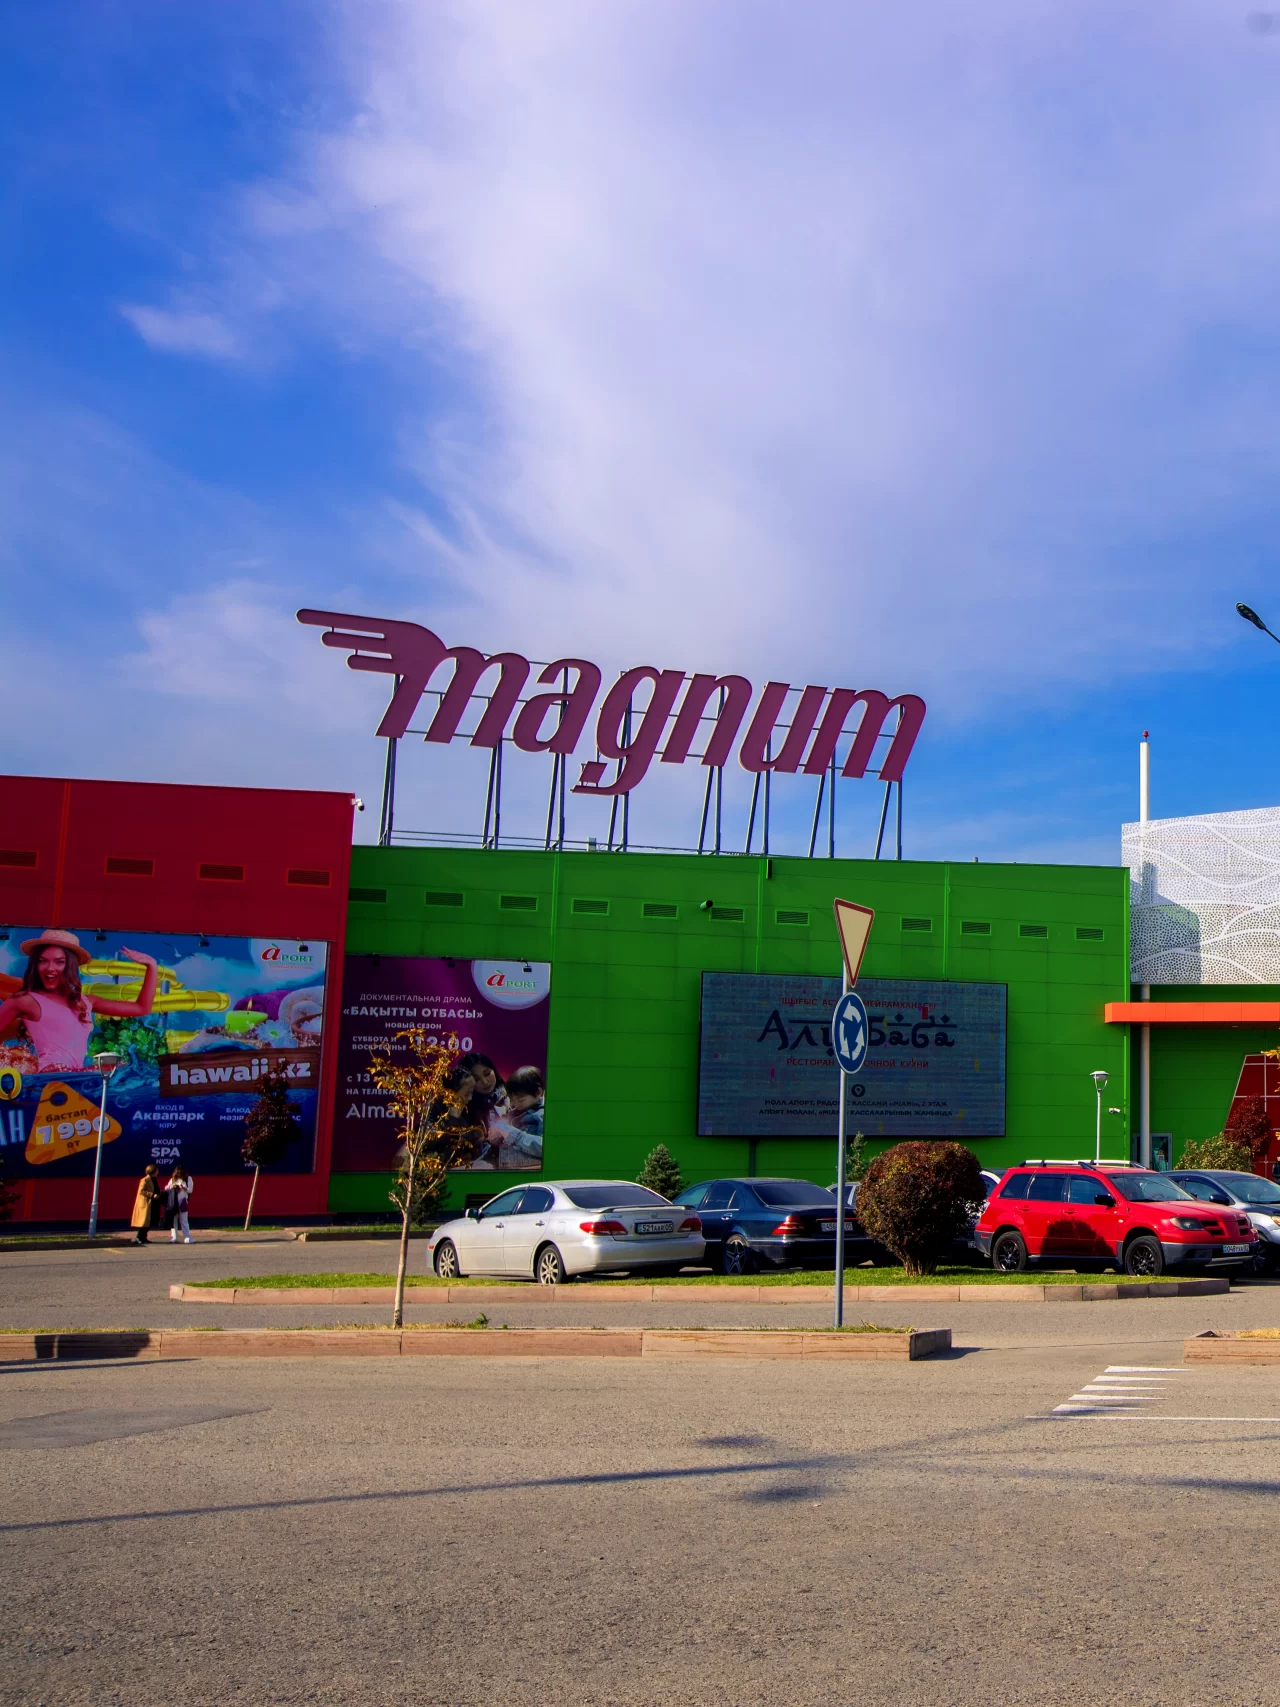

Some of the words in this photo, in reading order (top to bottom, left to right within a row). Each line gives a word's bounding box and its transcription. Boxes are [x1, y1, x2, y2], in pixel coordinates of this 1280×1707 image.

[297, 608, 927, 796] magnum
[359, 993, 440, 1003] ДОКУМЕНТАЛЬНАЯ
[442, 996, 472, 1004] ДРАМА
[342, 1006, 417, 1019] «БАҚЫТТЫ
[421, 1007, 483, 1019] ОТБАСЫ»
[384, 1021, 415, 1029] НОВЫЙ
[416, 1022, 442, 1030] СЕЗОН
[414, 1036, 473, 1052] 12:00
[786, 1059, 835, 1067] РЕСТОРАН
[169, 1057, 312, 1085] hawaii.kz
[357, 1073, 371, 1083] 13
[155, 1104, 177, 1112] ВХОД
[46, 1109, 88, 1122] бастап
[132, 1110, 205, 1122] Аквапарк
[67, 1140, 80, 1148] от
[152, 1138, 174, 1146] ВХОД
[151, 1147, 180, 1158] SPA
